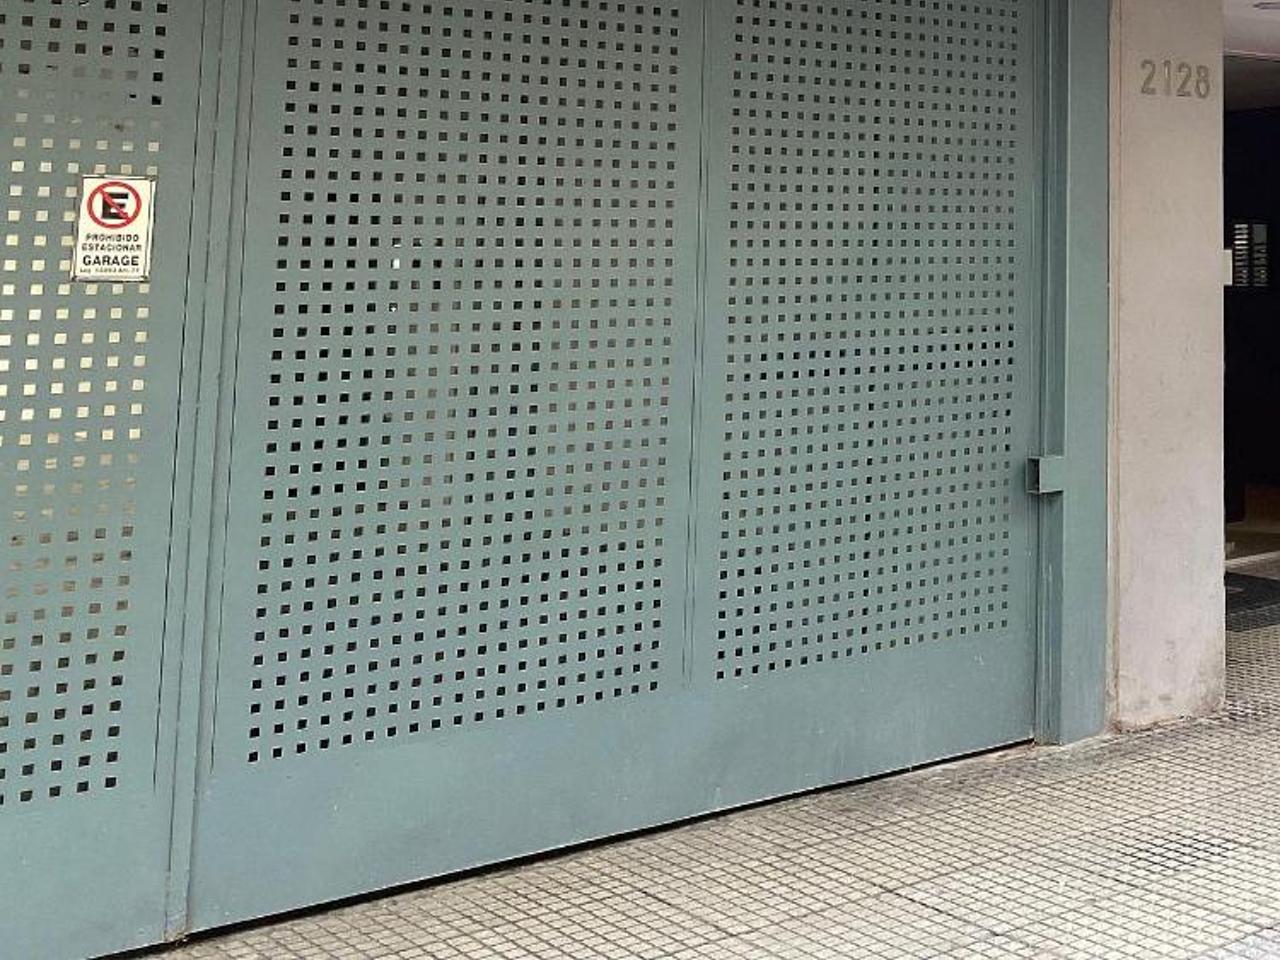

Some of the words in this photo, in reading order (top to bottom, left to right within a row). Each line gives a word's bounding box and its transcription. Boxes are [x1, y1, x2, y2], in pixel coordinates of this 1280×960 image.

[1140, 59, 1210, 99] 2128
[101, 192, 129, 219] E
[86, 233, 139, 242] PROHIBIDO
[81, 243, 141, 251] ESTACIONAR
[82, 255, 139, 266] GARAGE
